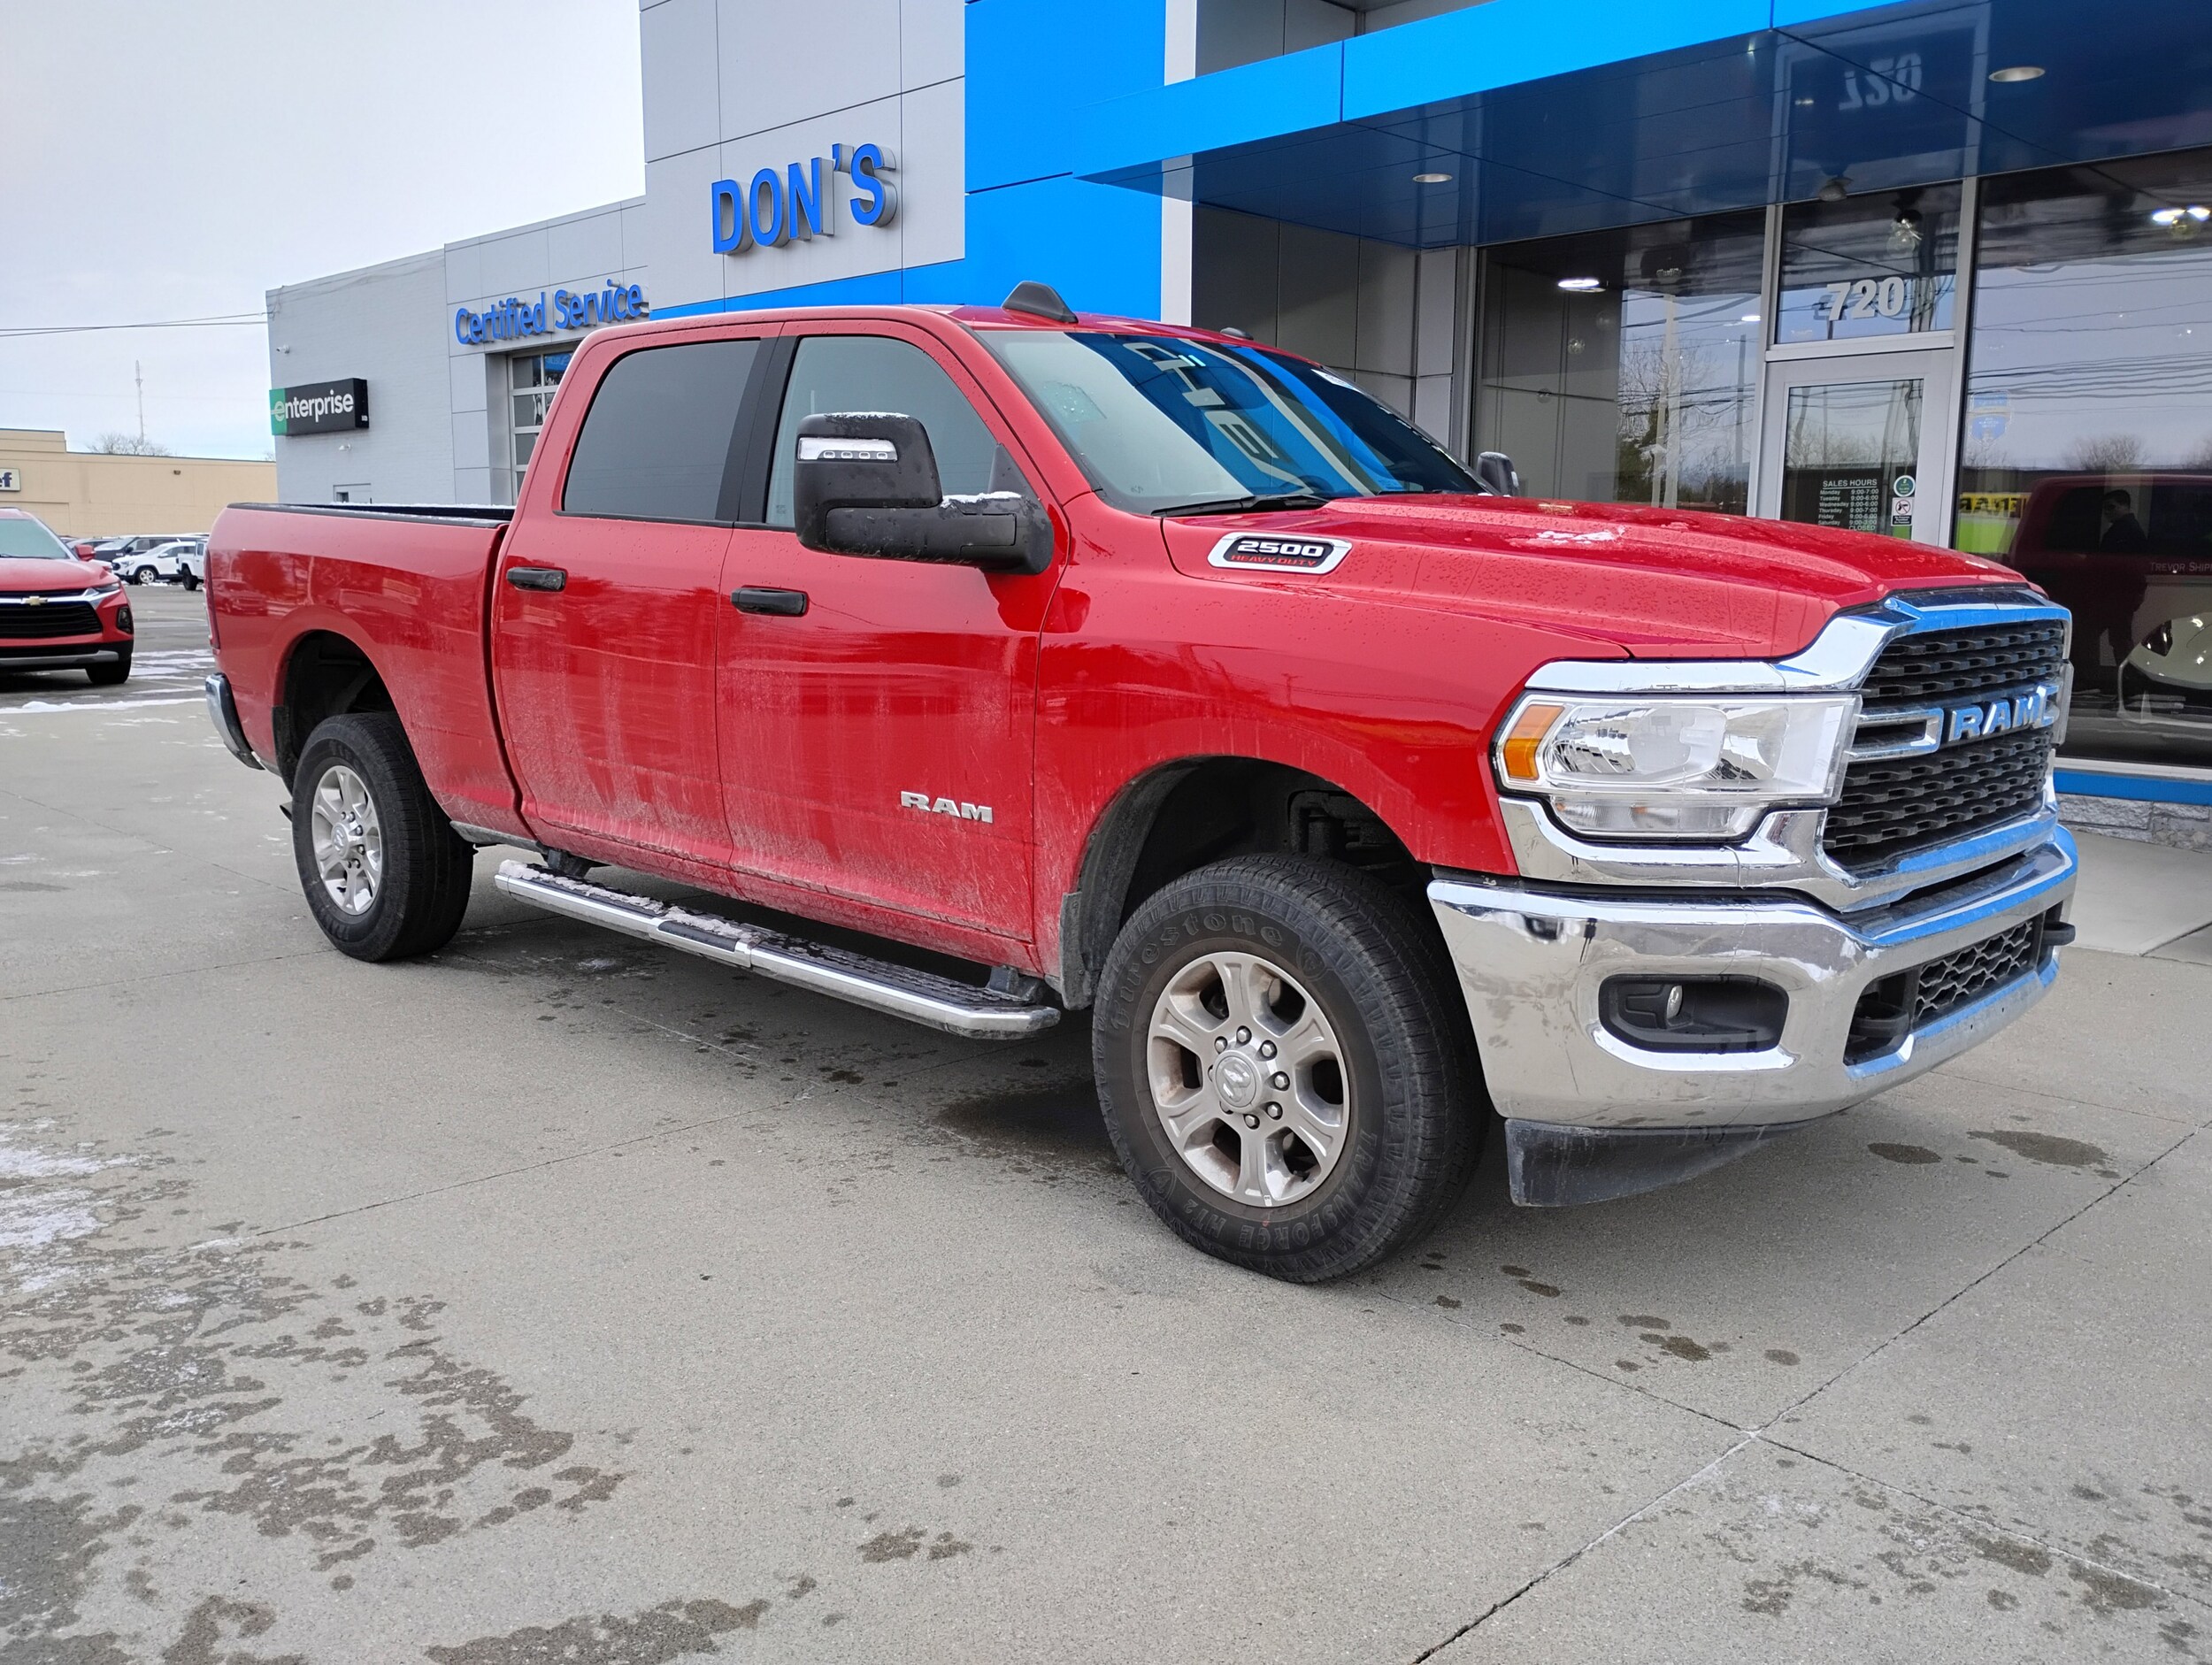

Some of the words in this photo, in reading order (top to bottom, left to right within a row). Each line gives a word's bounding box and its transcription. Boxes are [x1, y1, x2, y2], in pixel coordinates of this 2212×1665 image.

[711, 143, 892, 254] DON'S
[456, 292, 546, 345] Certified
[555, 279, 643, 330] Service
[1826, 276, 1905, 321] 720
[272, 389, 354, 423] enterprise
[1231, 555, 1275, 564] HEAVY
[1237, 541, 1324, 557] 2500
[2151, 562, 2185, 572] TREVOR
[2188, 561, 2212, 572] SHIP
[1948, 693, 2043, 741] RAM
[901, 790, 994, 824] RAM
